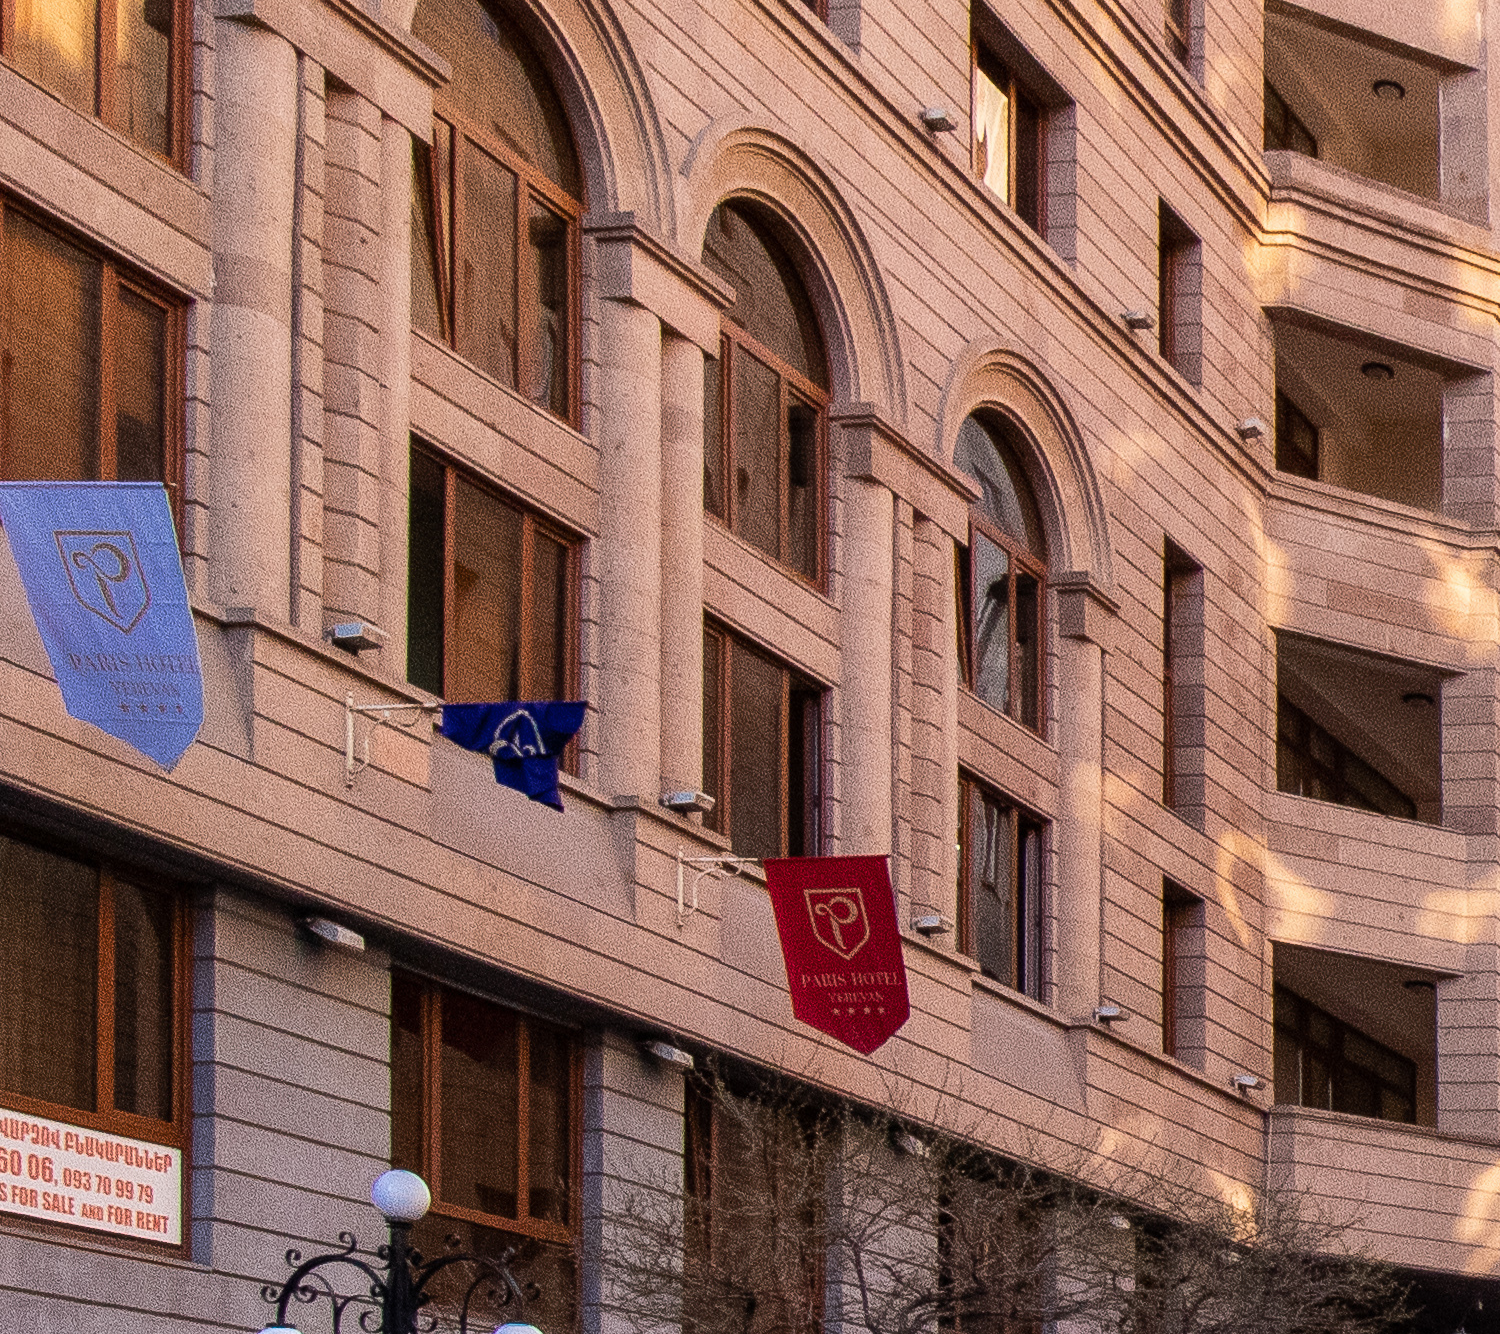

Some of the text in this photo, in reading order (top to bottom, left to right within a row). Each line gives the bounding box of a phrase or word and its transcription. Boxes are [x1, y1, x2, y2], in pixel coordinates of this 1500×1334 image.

[802, 971, 903, 988] PARIS HOTEL
[63, 1167, 92, 1192] 093
[95, 1174, 112, 1196] 70
[115, 1178, 134, 1200] 99
[137, 1183, 154, 1205] 79
[11, 1185, 39, 1209] FOR
[42, 1191, 75, 1216] SALE
[81, 1203, 104, 1222] AND
[107, 1204, 133, 1227] FOR
[136, 1210, 169, 1235] RENT
